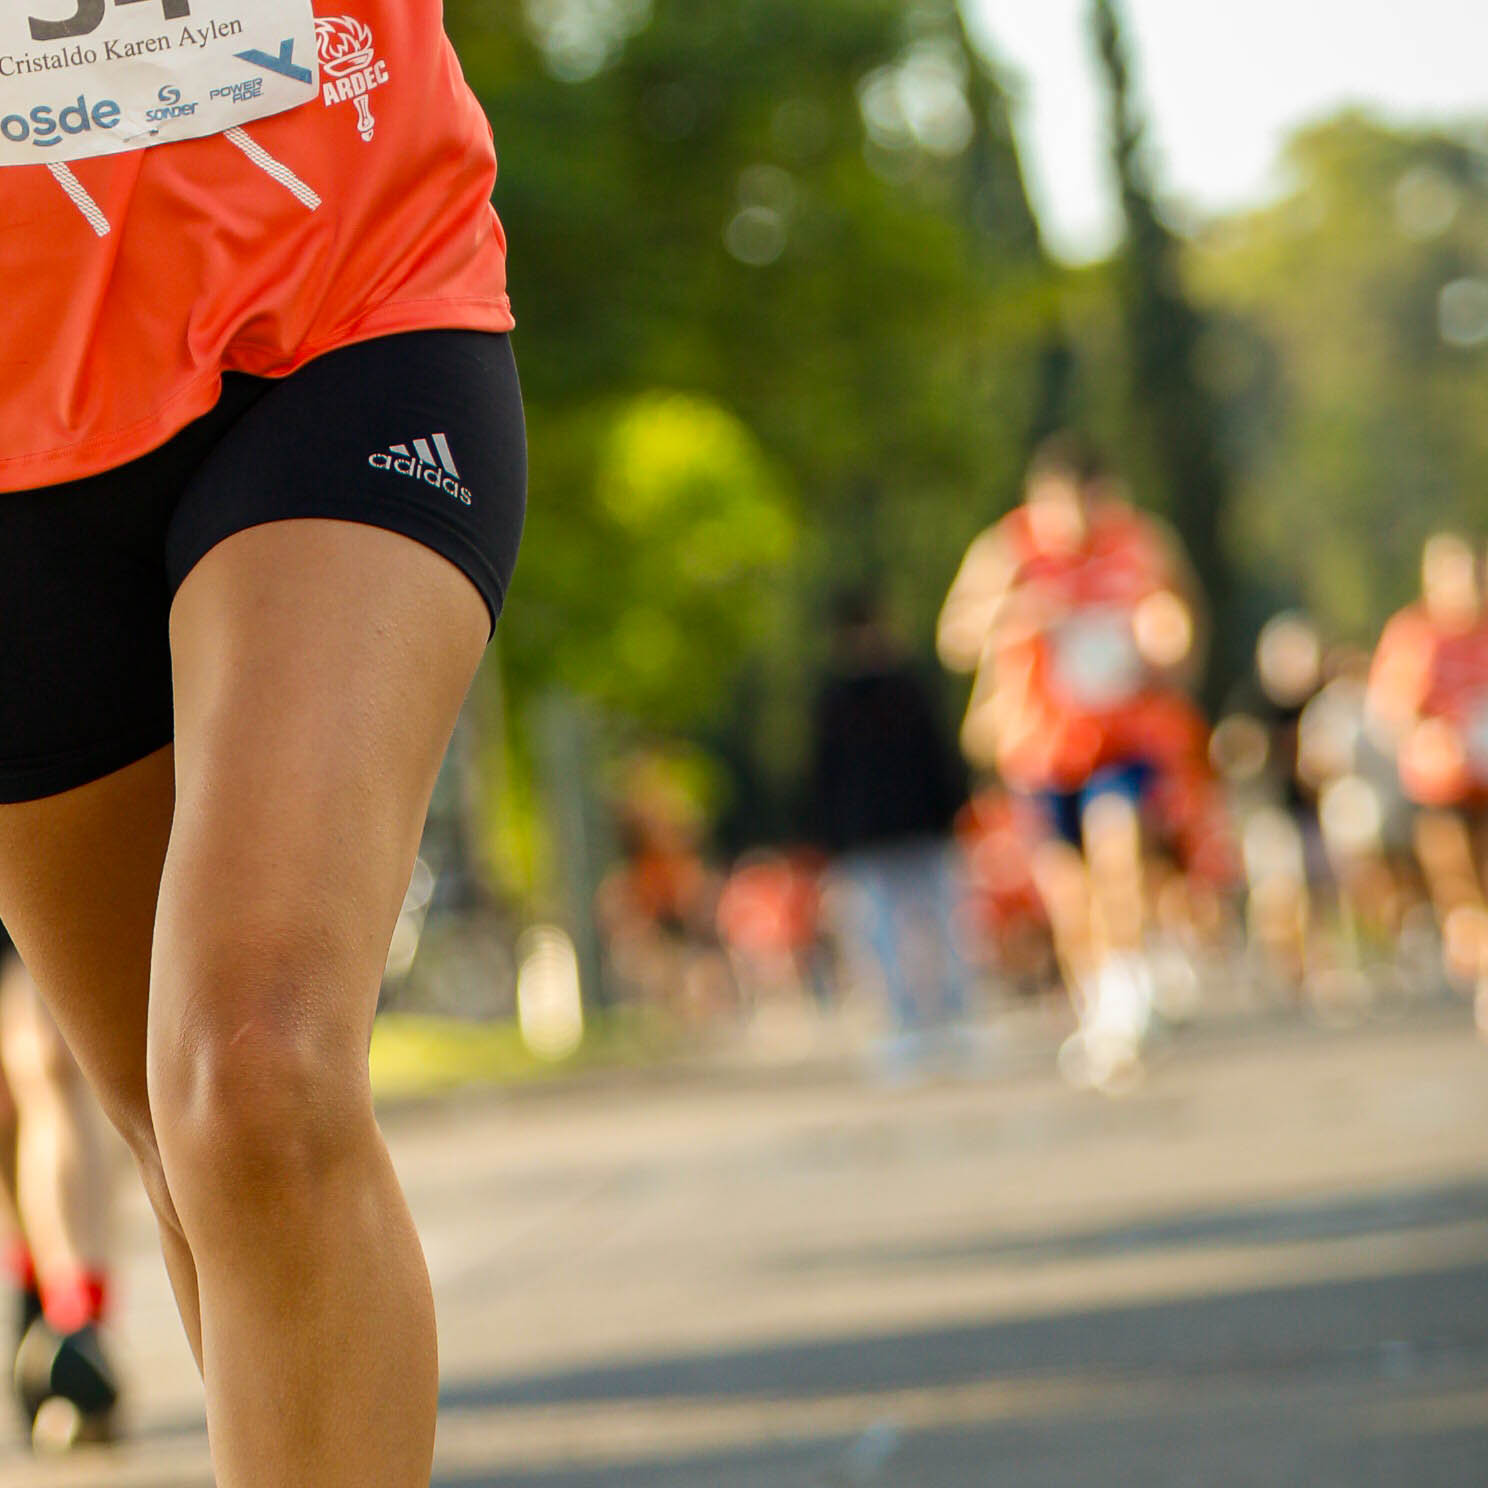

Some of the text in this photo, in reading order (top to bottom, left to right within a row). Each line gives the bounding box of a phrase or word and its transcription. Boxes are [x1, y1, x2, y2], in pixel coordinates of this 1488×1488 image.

[104, 33, 172, 61] Karen
[179, 19, 244, 49] Aylen
[209, 77, 263, 101] POWER
[322, 60, 390, 108] ARDEC
[0, 94, 121, 147] osde
[368, 453, 473, 506] adidas
